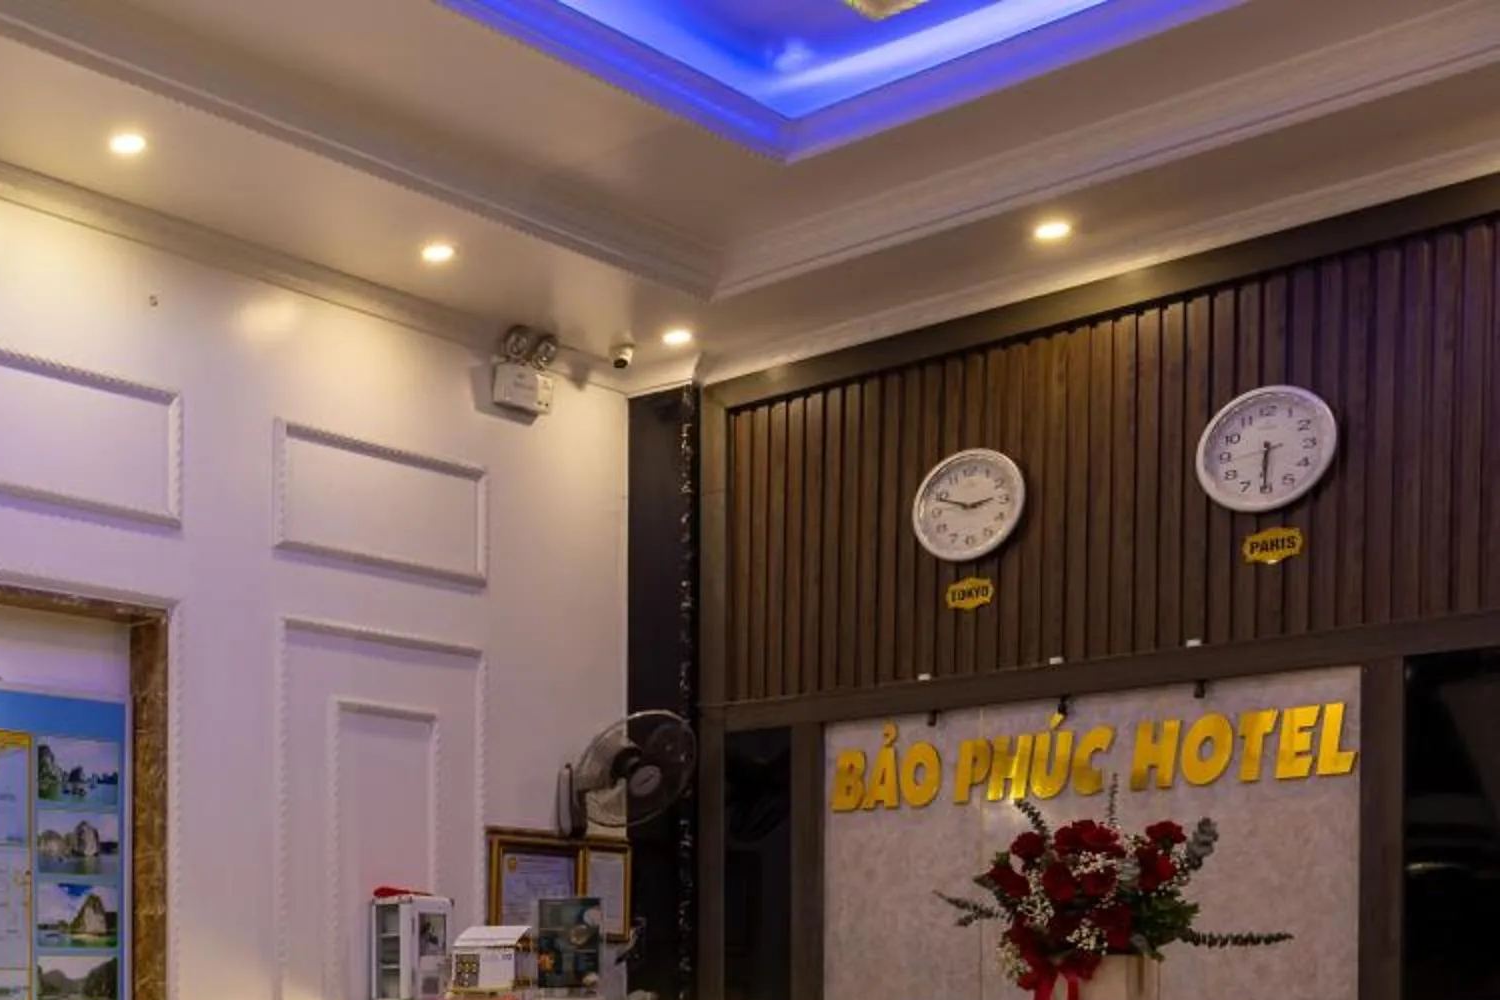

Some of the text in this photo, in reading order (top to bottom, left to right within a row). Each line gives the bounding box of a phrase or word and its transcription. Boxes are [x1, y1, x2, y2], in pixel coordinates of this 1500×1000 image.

[1259, 405, 1277, 417] 12
[1298, 419, 1311, 431] 2
[1225, 433, 1241, 444] 10
[1303, 437, 1317, 449] 3
[1220, 452, 1231, 464] 9
[1297, 457, 1309, 467] 4
[1225, 469, 1237, 480] 8
[1239, 481, 1251, 493] 7
[1250, 535, 1298, 553] PARIS
[951, 586, 989, 602] TOKYO
[830, 703, 1359, 813] BẢO PHÚC HOTEL
